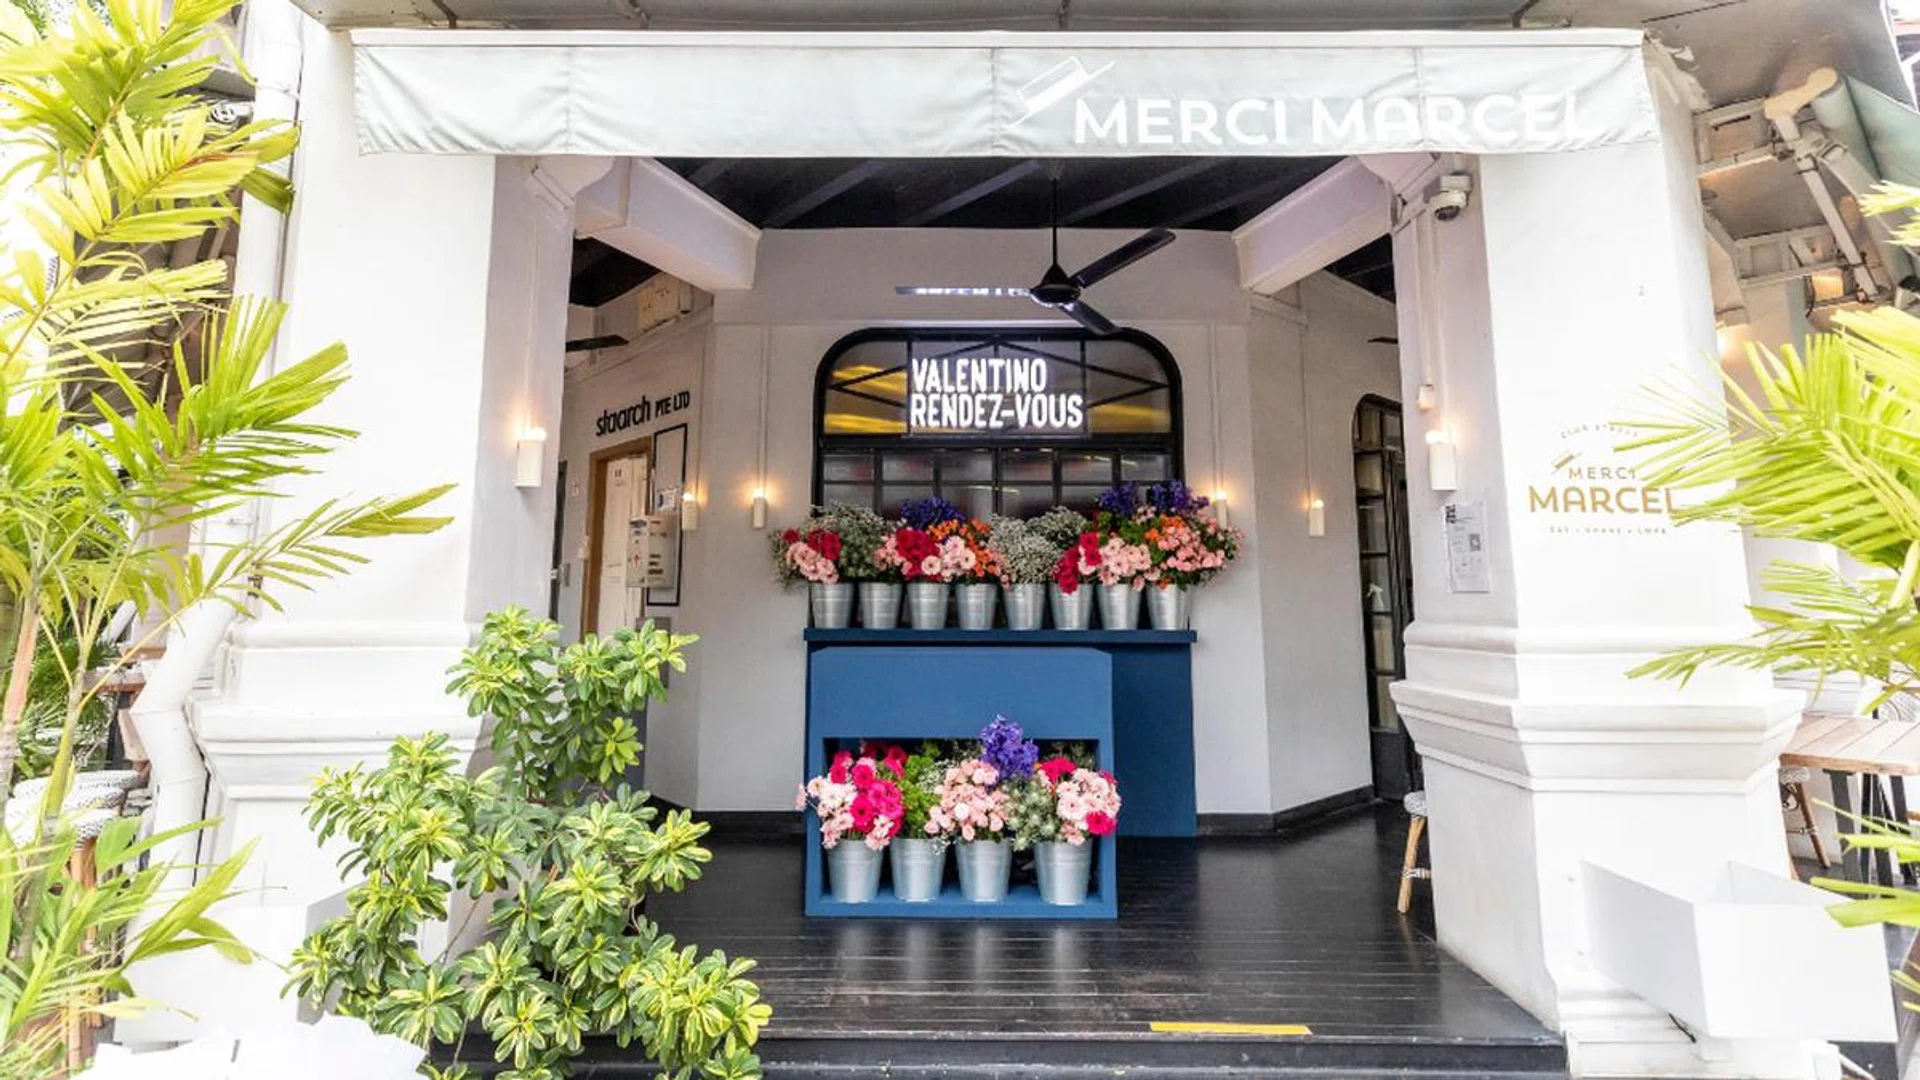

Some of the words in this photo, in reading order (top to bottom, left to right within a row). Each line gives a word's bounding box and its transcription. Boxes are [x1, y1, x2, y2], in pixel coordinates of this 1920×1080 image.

[1075, 97, 1287, 146] MERCI
[1312, 92, 1604, 145] MARCEL
[911, 357, 1048, 393] VALENTINO
[595, 394, 651, 437] staarch
[654, 396, 673, 419] PTE
[673, 390, 691, 413] LTD
[910, 393, 1084, 429] RENDEZ-VOUS
[1568, 466, 1636, 480] MERCI
[1528, 485, 1684, 514] MARCEL
